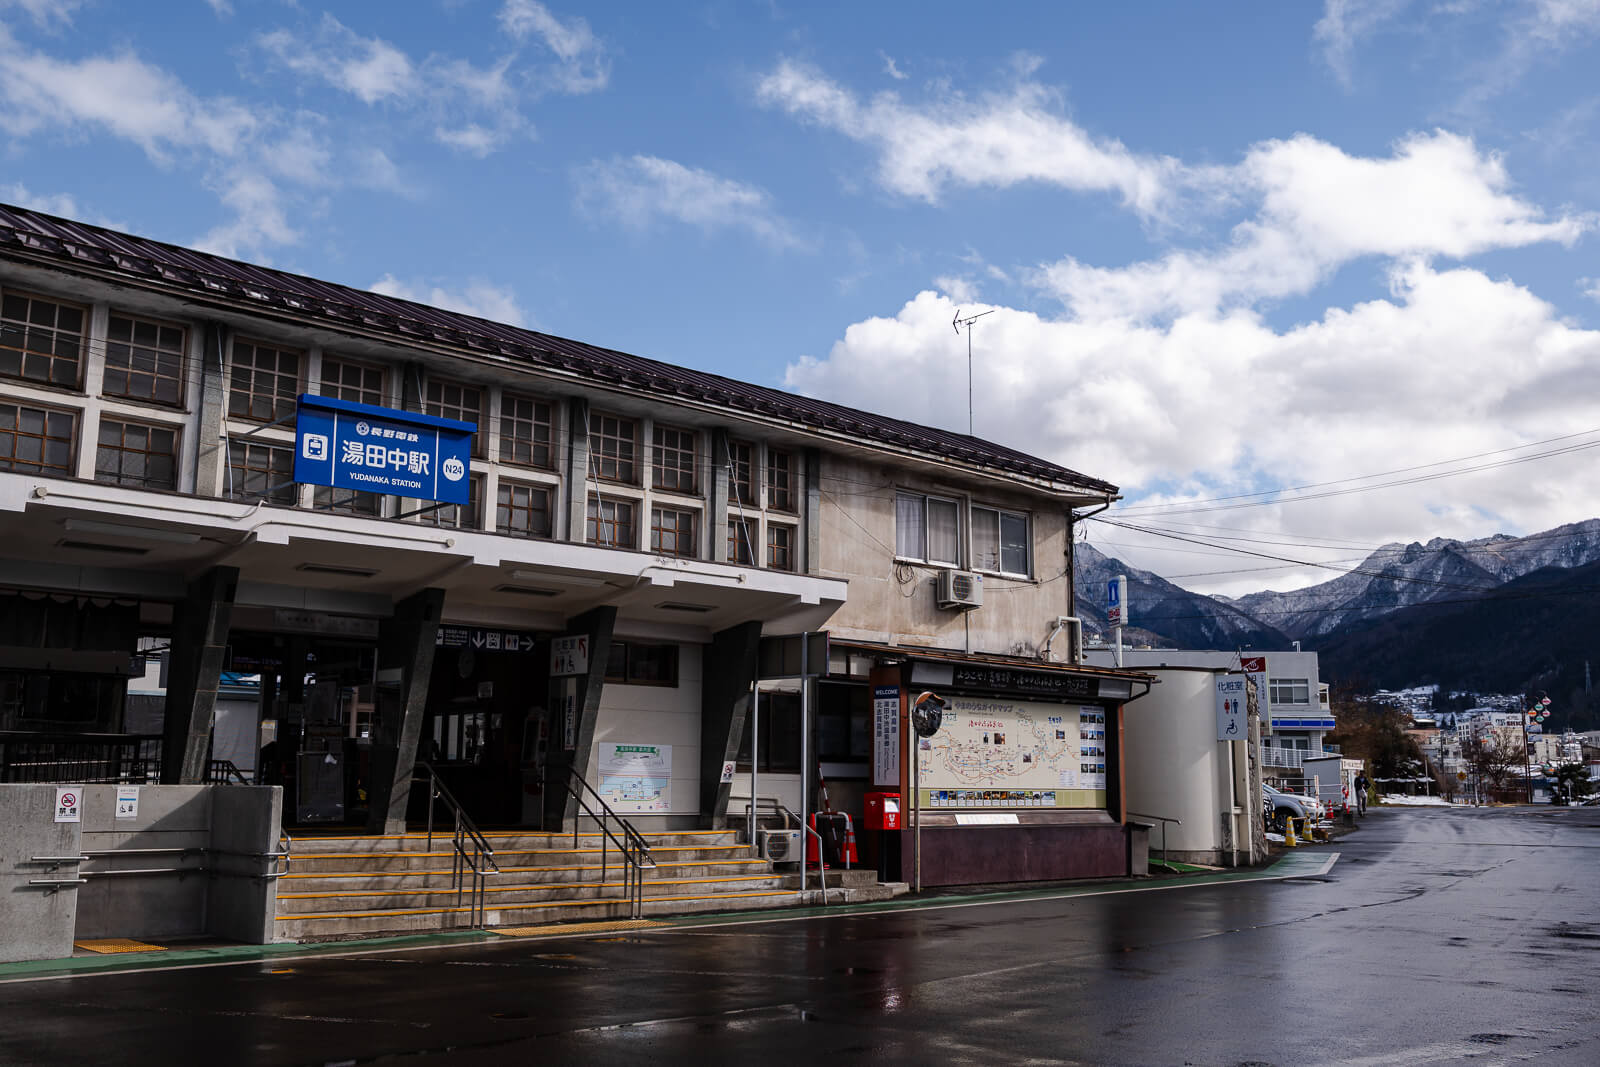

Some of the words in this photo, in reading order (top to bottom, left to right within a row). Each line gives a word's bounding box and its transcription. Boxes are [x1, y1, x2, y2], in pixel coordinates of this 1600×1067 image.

[371, 427, 419, 442] 長野電鉄
[342, 440, 429, 475] 湯田中駅
[445, 464, 462, 474] N24
[349, 472, 389, 484] YUDANAKA
[391, 478, 421, 488] STATION
[1218, 681, 1243, 691] 化粧室
